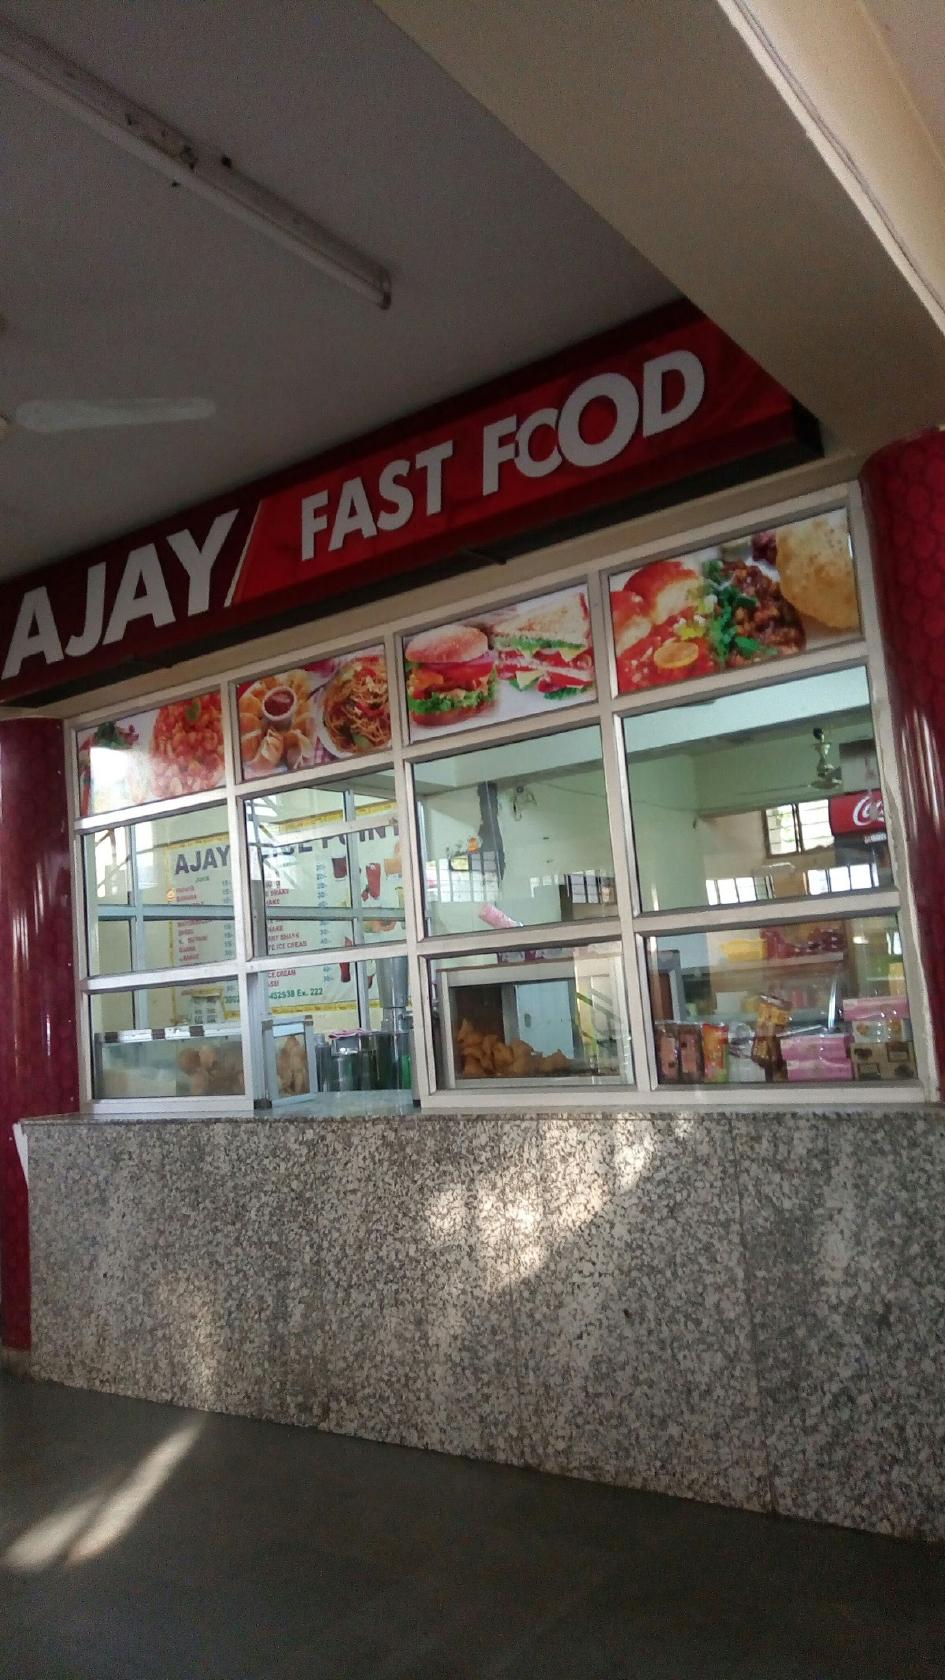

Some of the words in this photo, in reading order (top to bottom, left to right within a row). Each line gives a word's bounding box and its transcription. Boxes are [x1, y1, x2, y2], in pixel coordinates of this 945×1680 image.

[1, 508, 240, 681] AJAY
[301, 441, 454, 562] FAST
[175, 845, 231, 875] AJAY
[310, 987, 324, 996] 222
